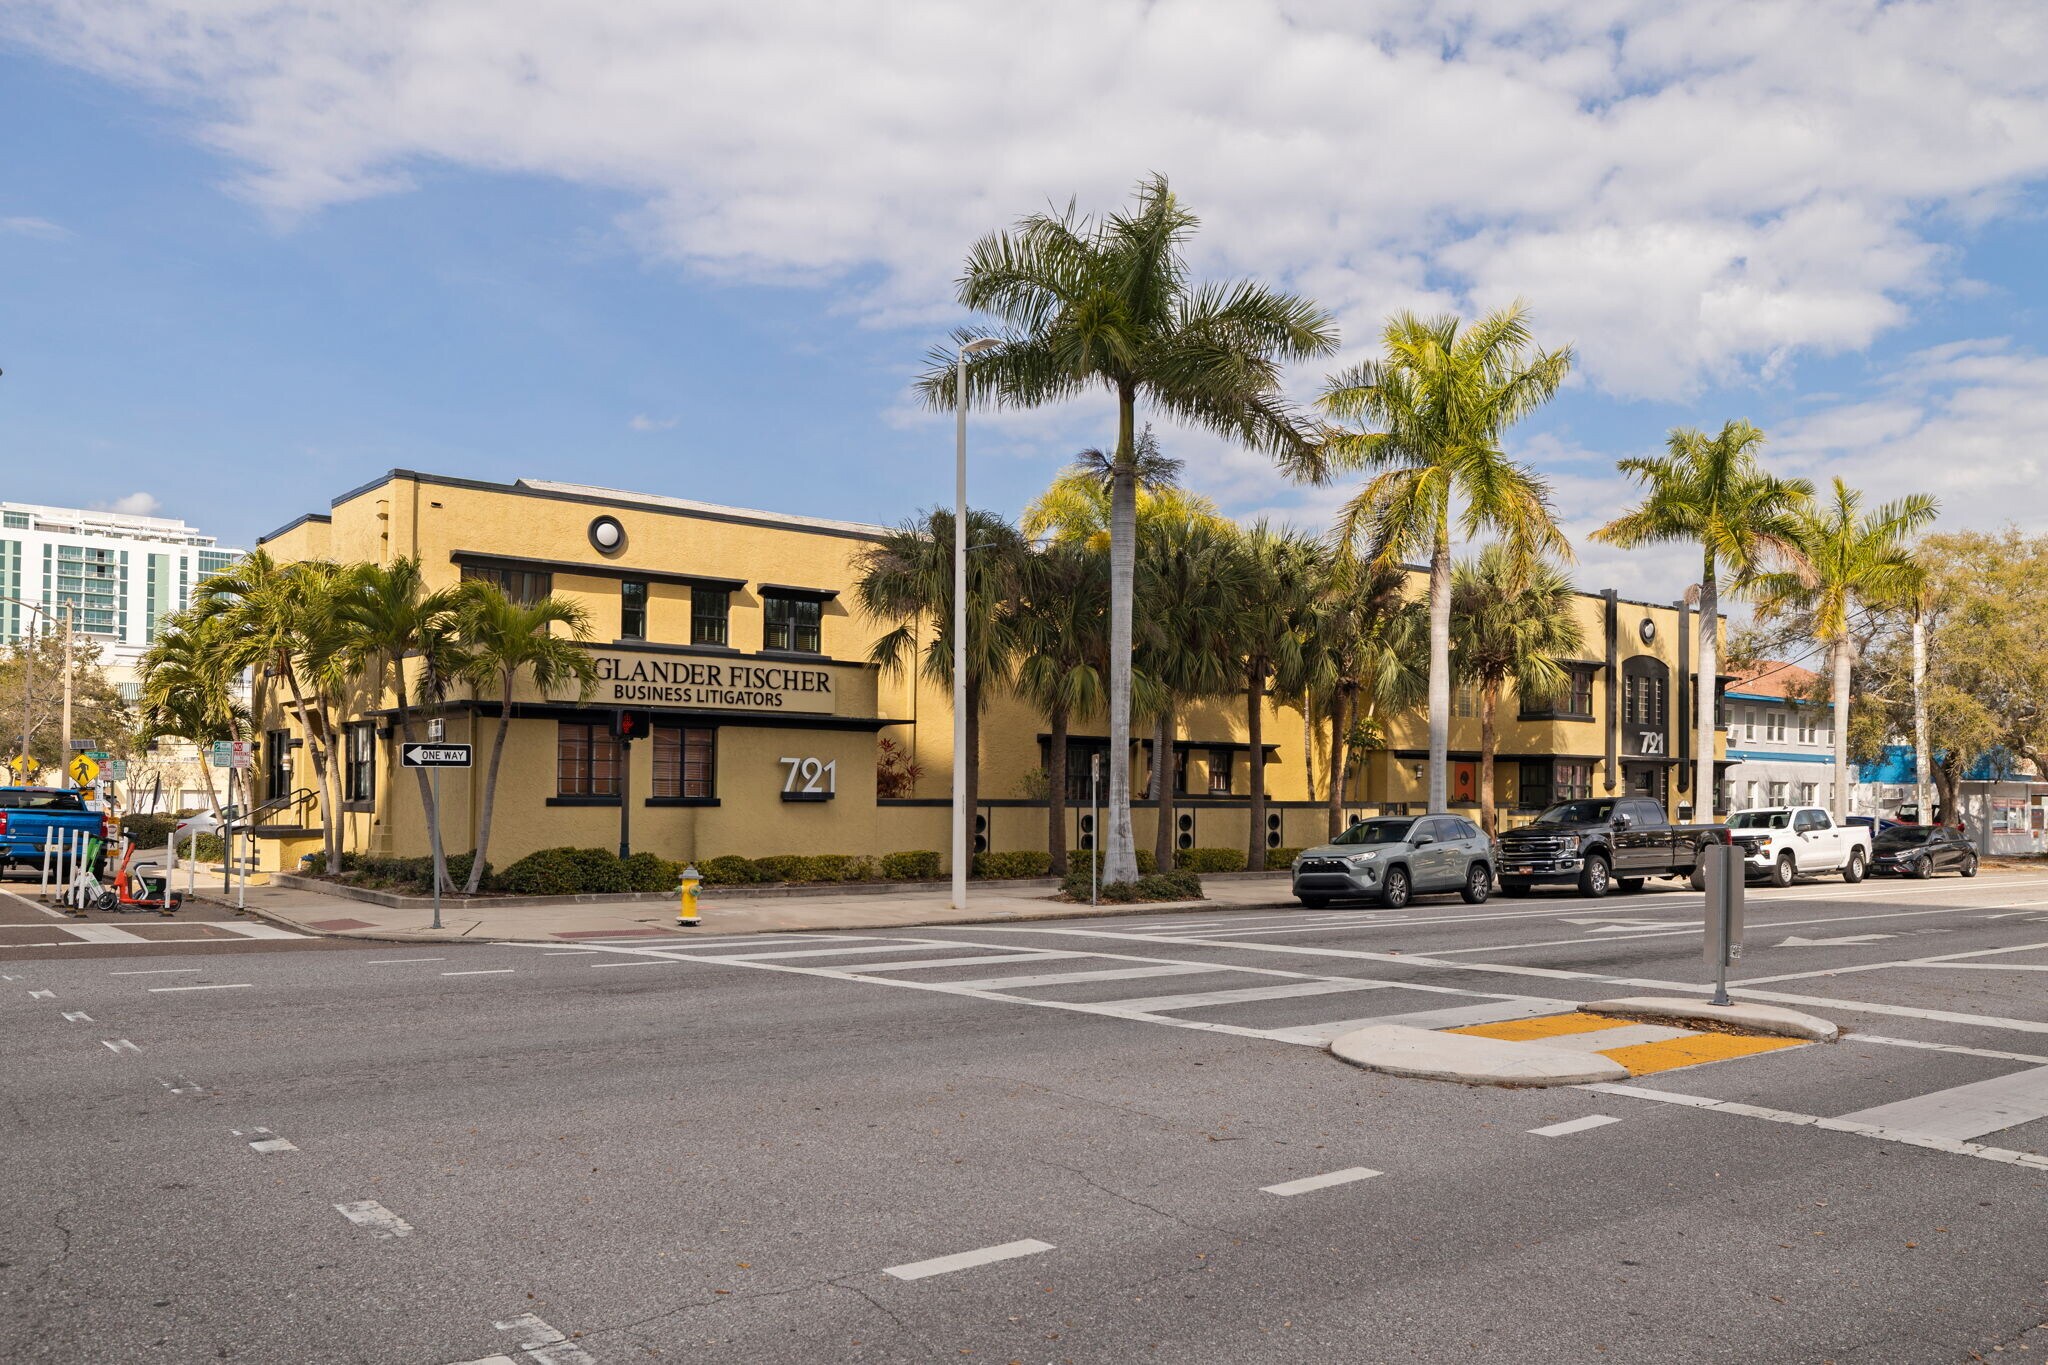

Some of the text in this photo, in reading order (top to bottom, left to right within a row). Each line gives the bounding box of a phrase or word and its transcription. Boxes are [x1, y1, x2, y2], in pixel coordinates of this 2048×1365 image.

[565, 657, 832, 693] GLANDER FISCHER
[614, 684, 783, 707] BUSINESS LITIGATORS
[1639, 731, 1664, 754] 721
[422, 750, 464, 760] ONE WAY
[780, 756, 836, 793] 721
